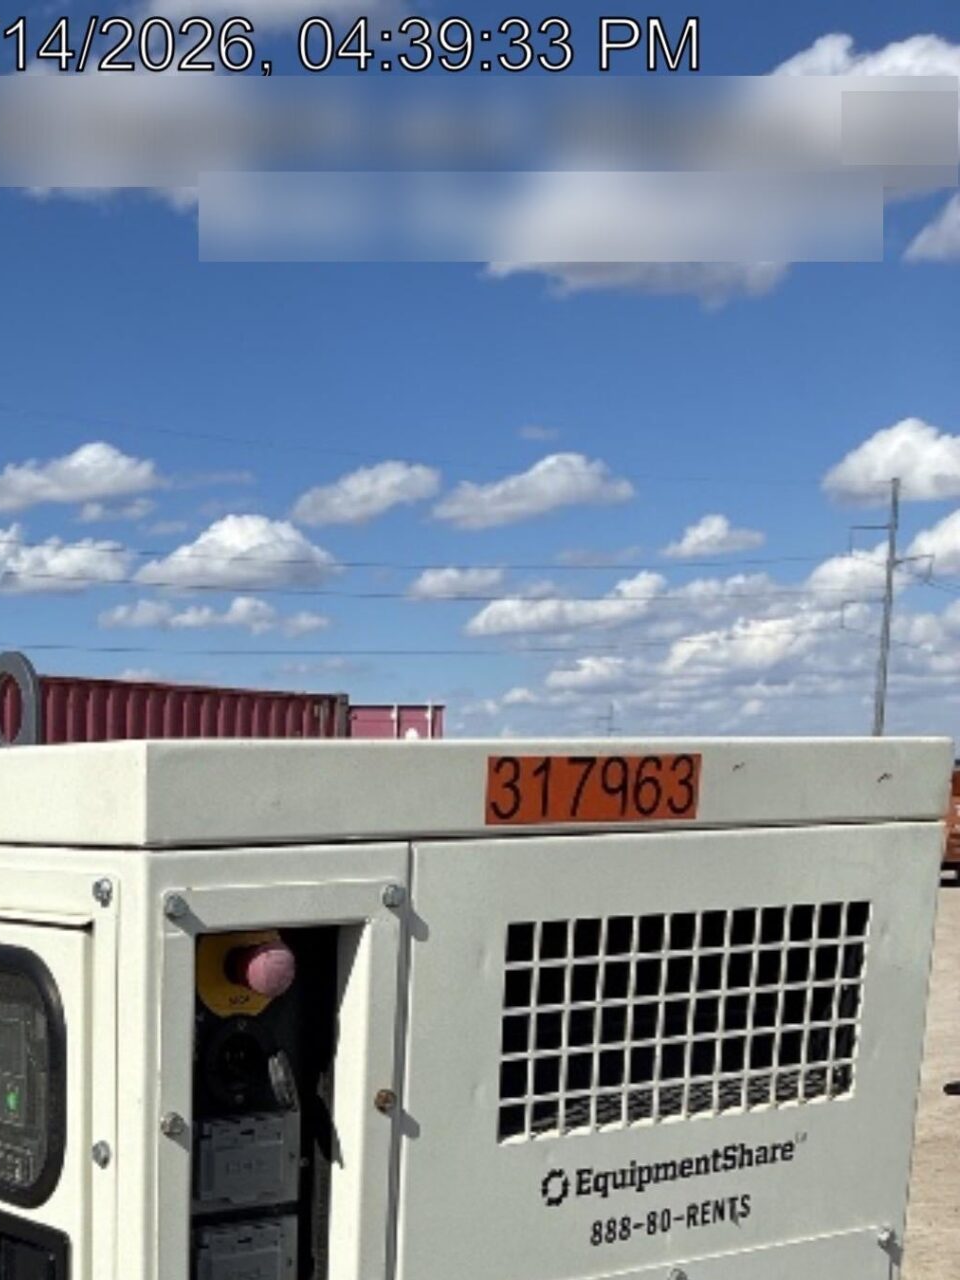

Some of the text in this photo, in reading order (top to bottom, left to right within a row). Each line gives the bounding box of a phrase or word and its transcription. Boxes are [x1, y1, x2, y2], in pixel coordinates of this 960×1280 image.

[490, 754, 695, 820] 317963
[575, 1140, 795, 1198] EquipmentShare
[590, 1194, 751, 1247] 888-80-RENTS
